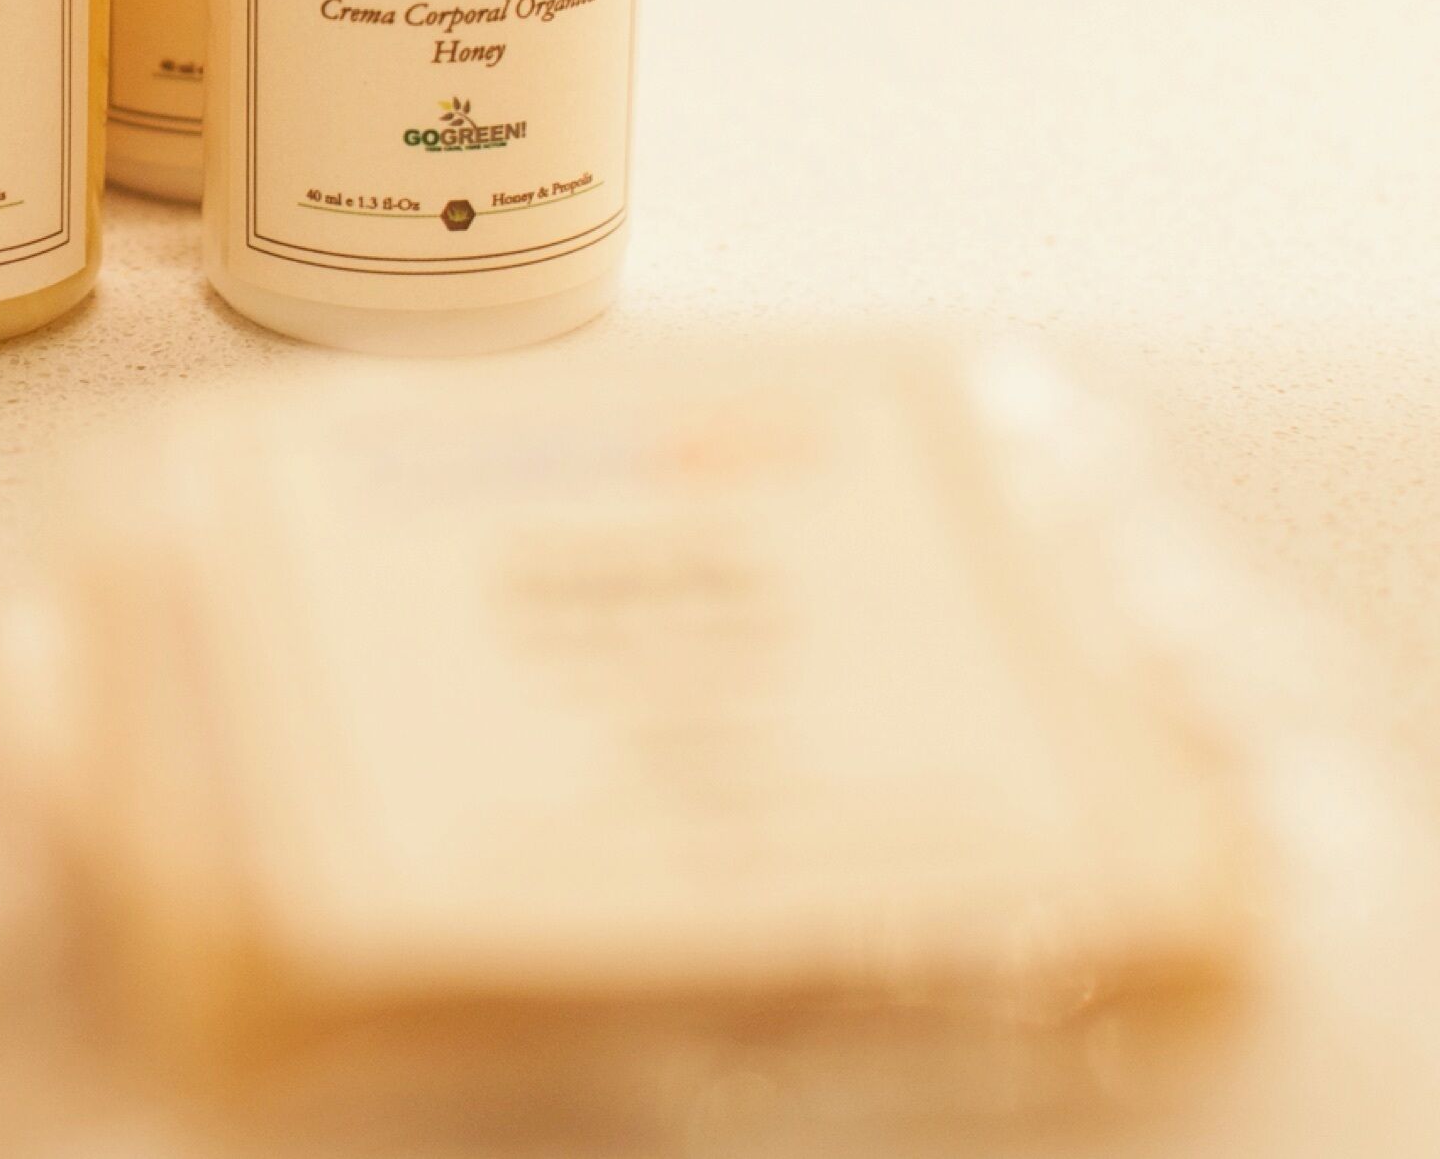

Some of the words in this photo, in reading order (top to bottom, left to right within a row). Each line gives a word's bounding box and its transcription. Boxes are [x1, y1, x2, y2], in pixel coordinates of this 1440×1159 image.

[431, 40, 506, 68] Honey
[403, 120, 527, 147] GOGREEN!
[306, 189, 322, 203] 40
[324, 193, 342, 206] ml
[359, 196, 378, 210] 1.3
[492, 192, 535, 208] Honey
[537, 186, 549, 199] &
